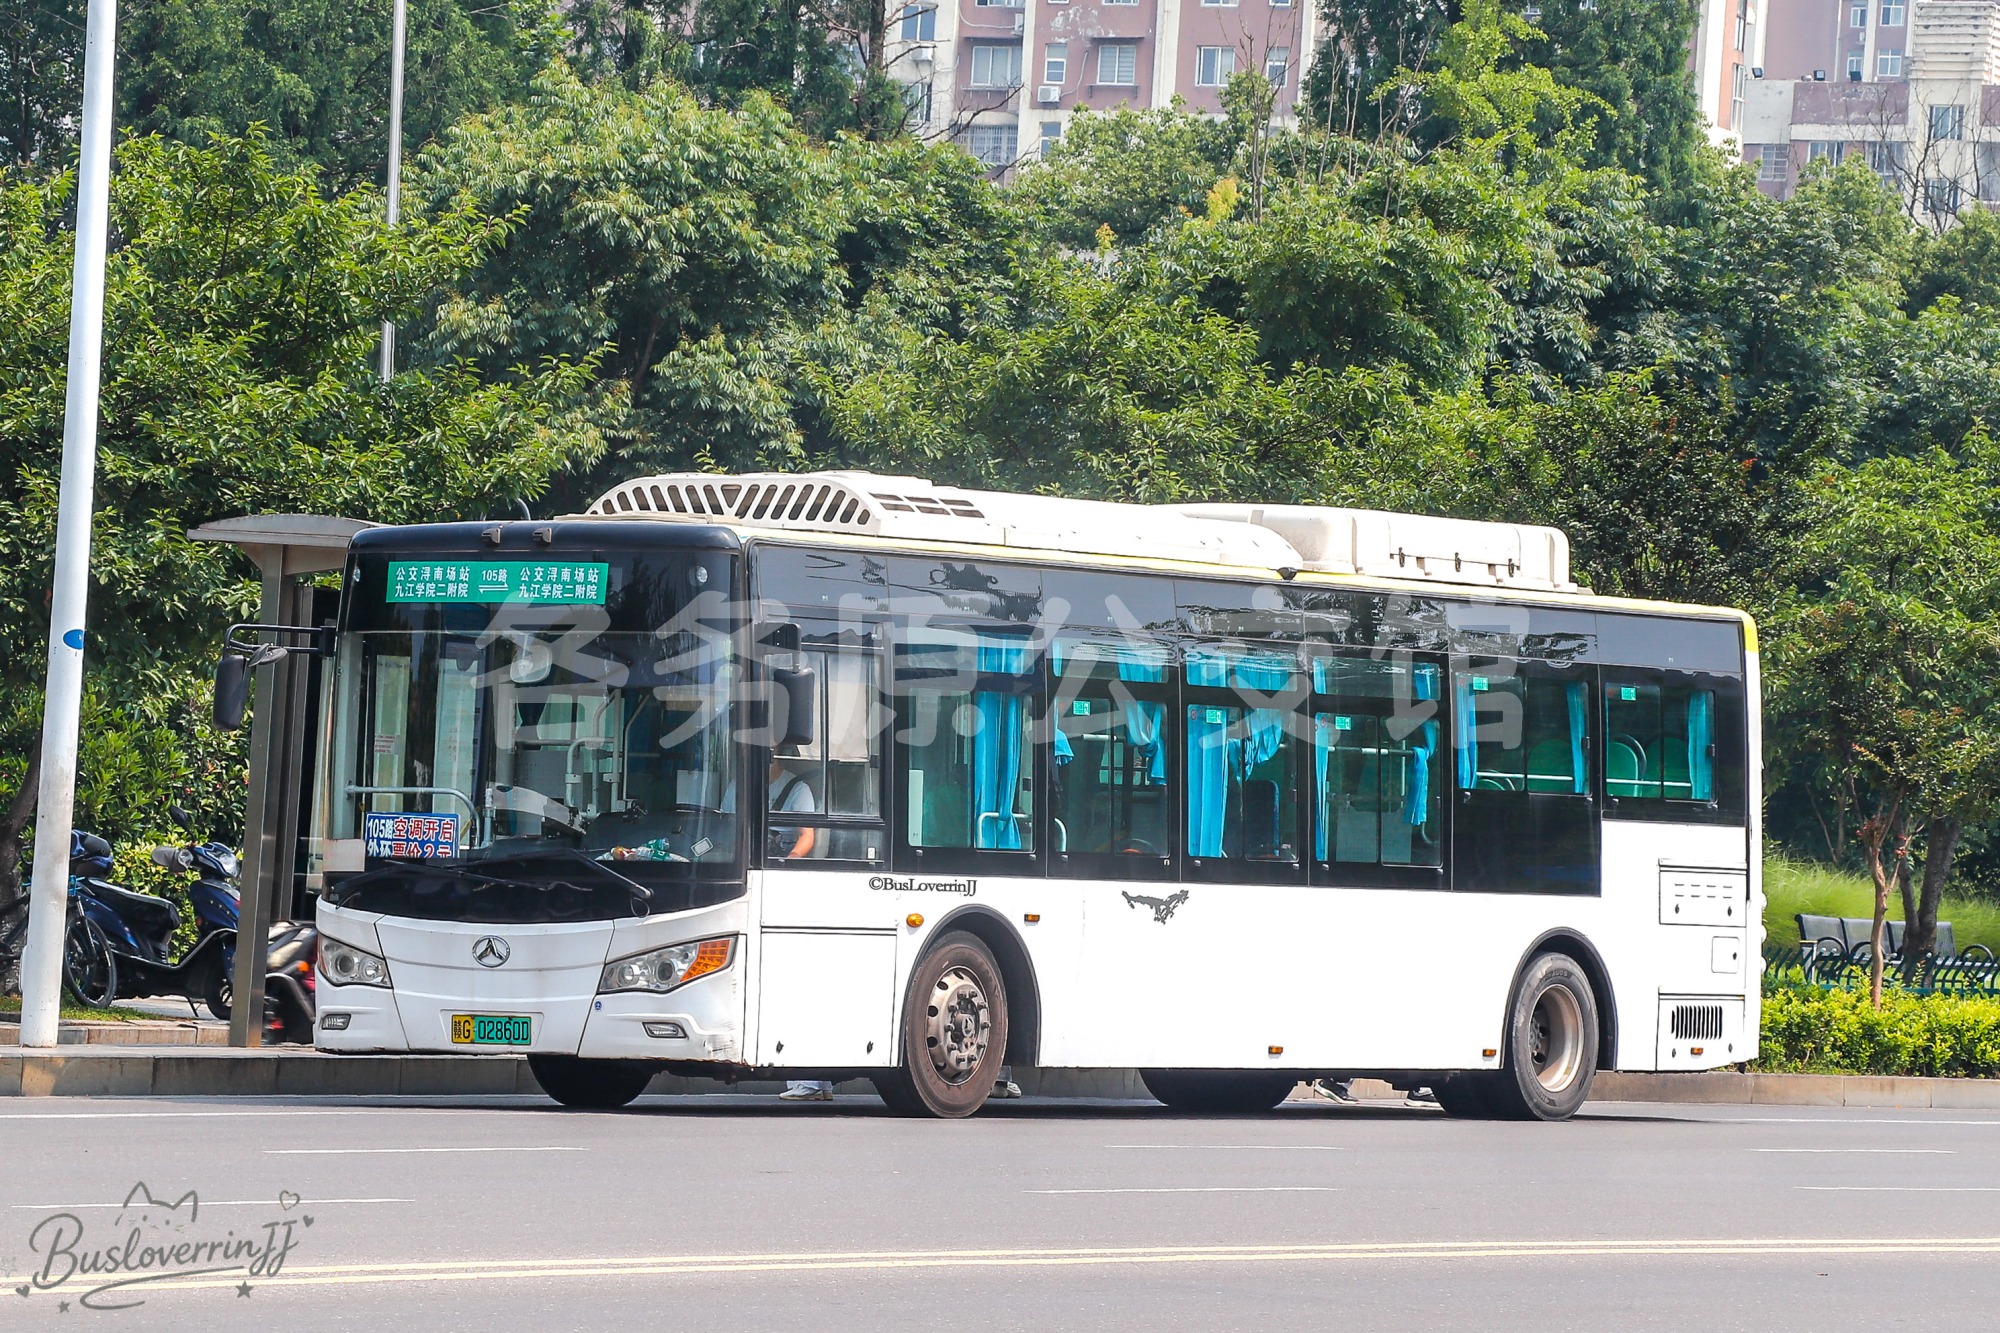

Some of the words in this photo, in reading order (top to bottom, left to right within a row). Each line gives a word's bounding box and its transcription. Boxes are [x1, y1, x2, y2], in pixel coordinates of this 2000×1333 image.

[395, 566, 471, 582] 公交浔南场站
[481, 569, 508, 583] 105路
[519, 566, 599, 583] 公交浔南场站
[394, 583, 469, 598] 九江学院二附院
[518, 583, 598, 600] 九江学院二附院
